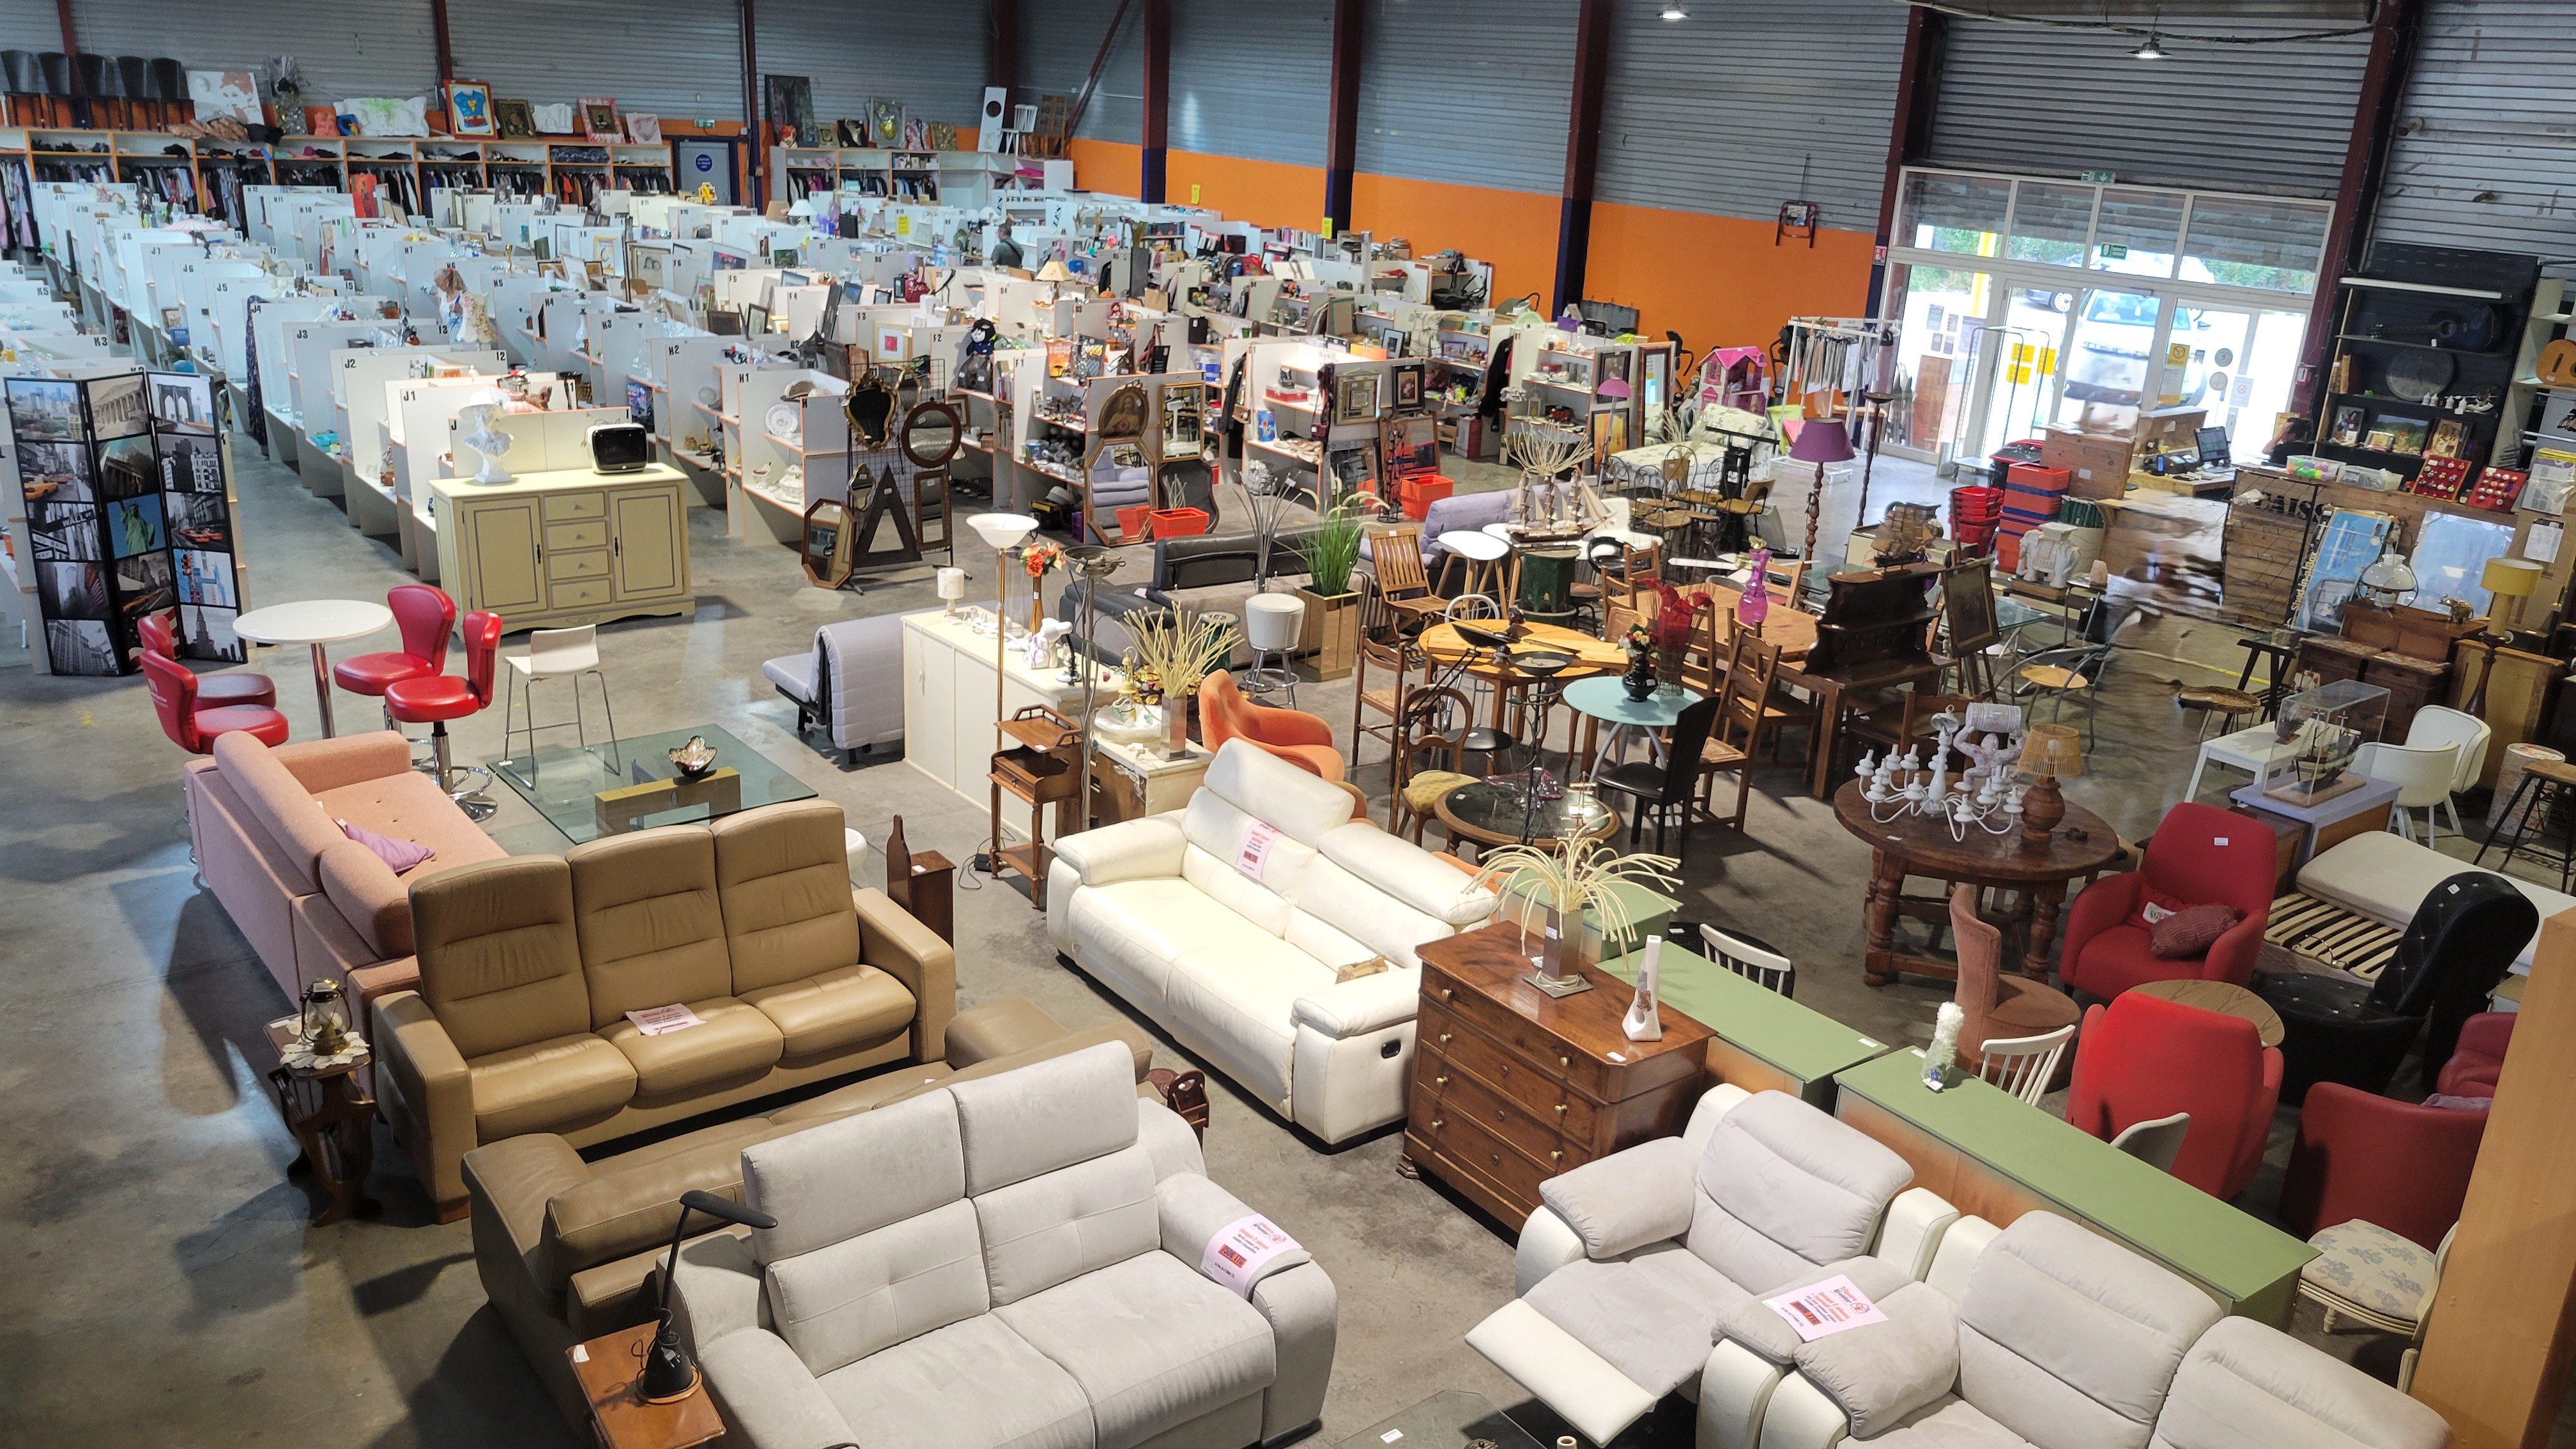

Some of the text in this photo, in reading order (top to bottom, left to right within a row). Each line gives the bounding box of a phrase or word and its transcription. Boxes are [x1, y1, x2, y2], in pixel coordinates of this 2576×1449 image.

[270, 247, 277, 255] I7
[404, 246, 413, 254] H7
[12, 266, 24, 275] K6
[183, 264, 194, 273] J6
[730, 275, 737, 283] F5
[37, 287, 49, 296] K5
[217, 283, 227, 291] J5
[63, 309, 75, 318] K4
[252, 305, 261, 313] J4
[438, 324, 448, 334] I3
[602, 319, 611, 330] H3
[296, 330, 308, 339] J3
[933, 334, 942, 342] F2
[94, 337, 108, 346] K3
[669, 346, 680, 355] H2
[496, 351, 506, 362] I2
[344, 359, 356, 369] J2
[1016, 358, 1023, 368] F1
[739, 372, 749, 383] H1
[404, 392, 416, 401] J1
[802, 398, 808, 408] H
[450, 420, 457, 431] J
